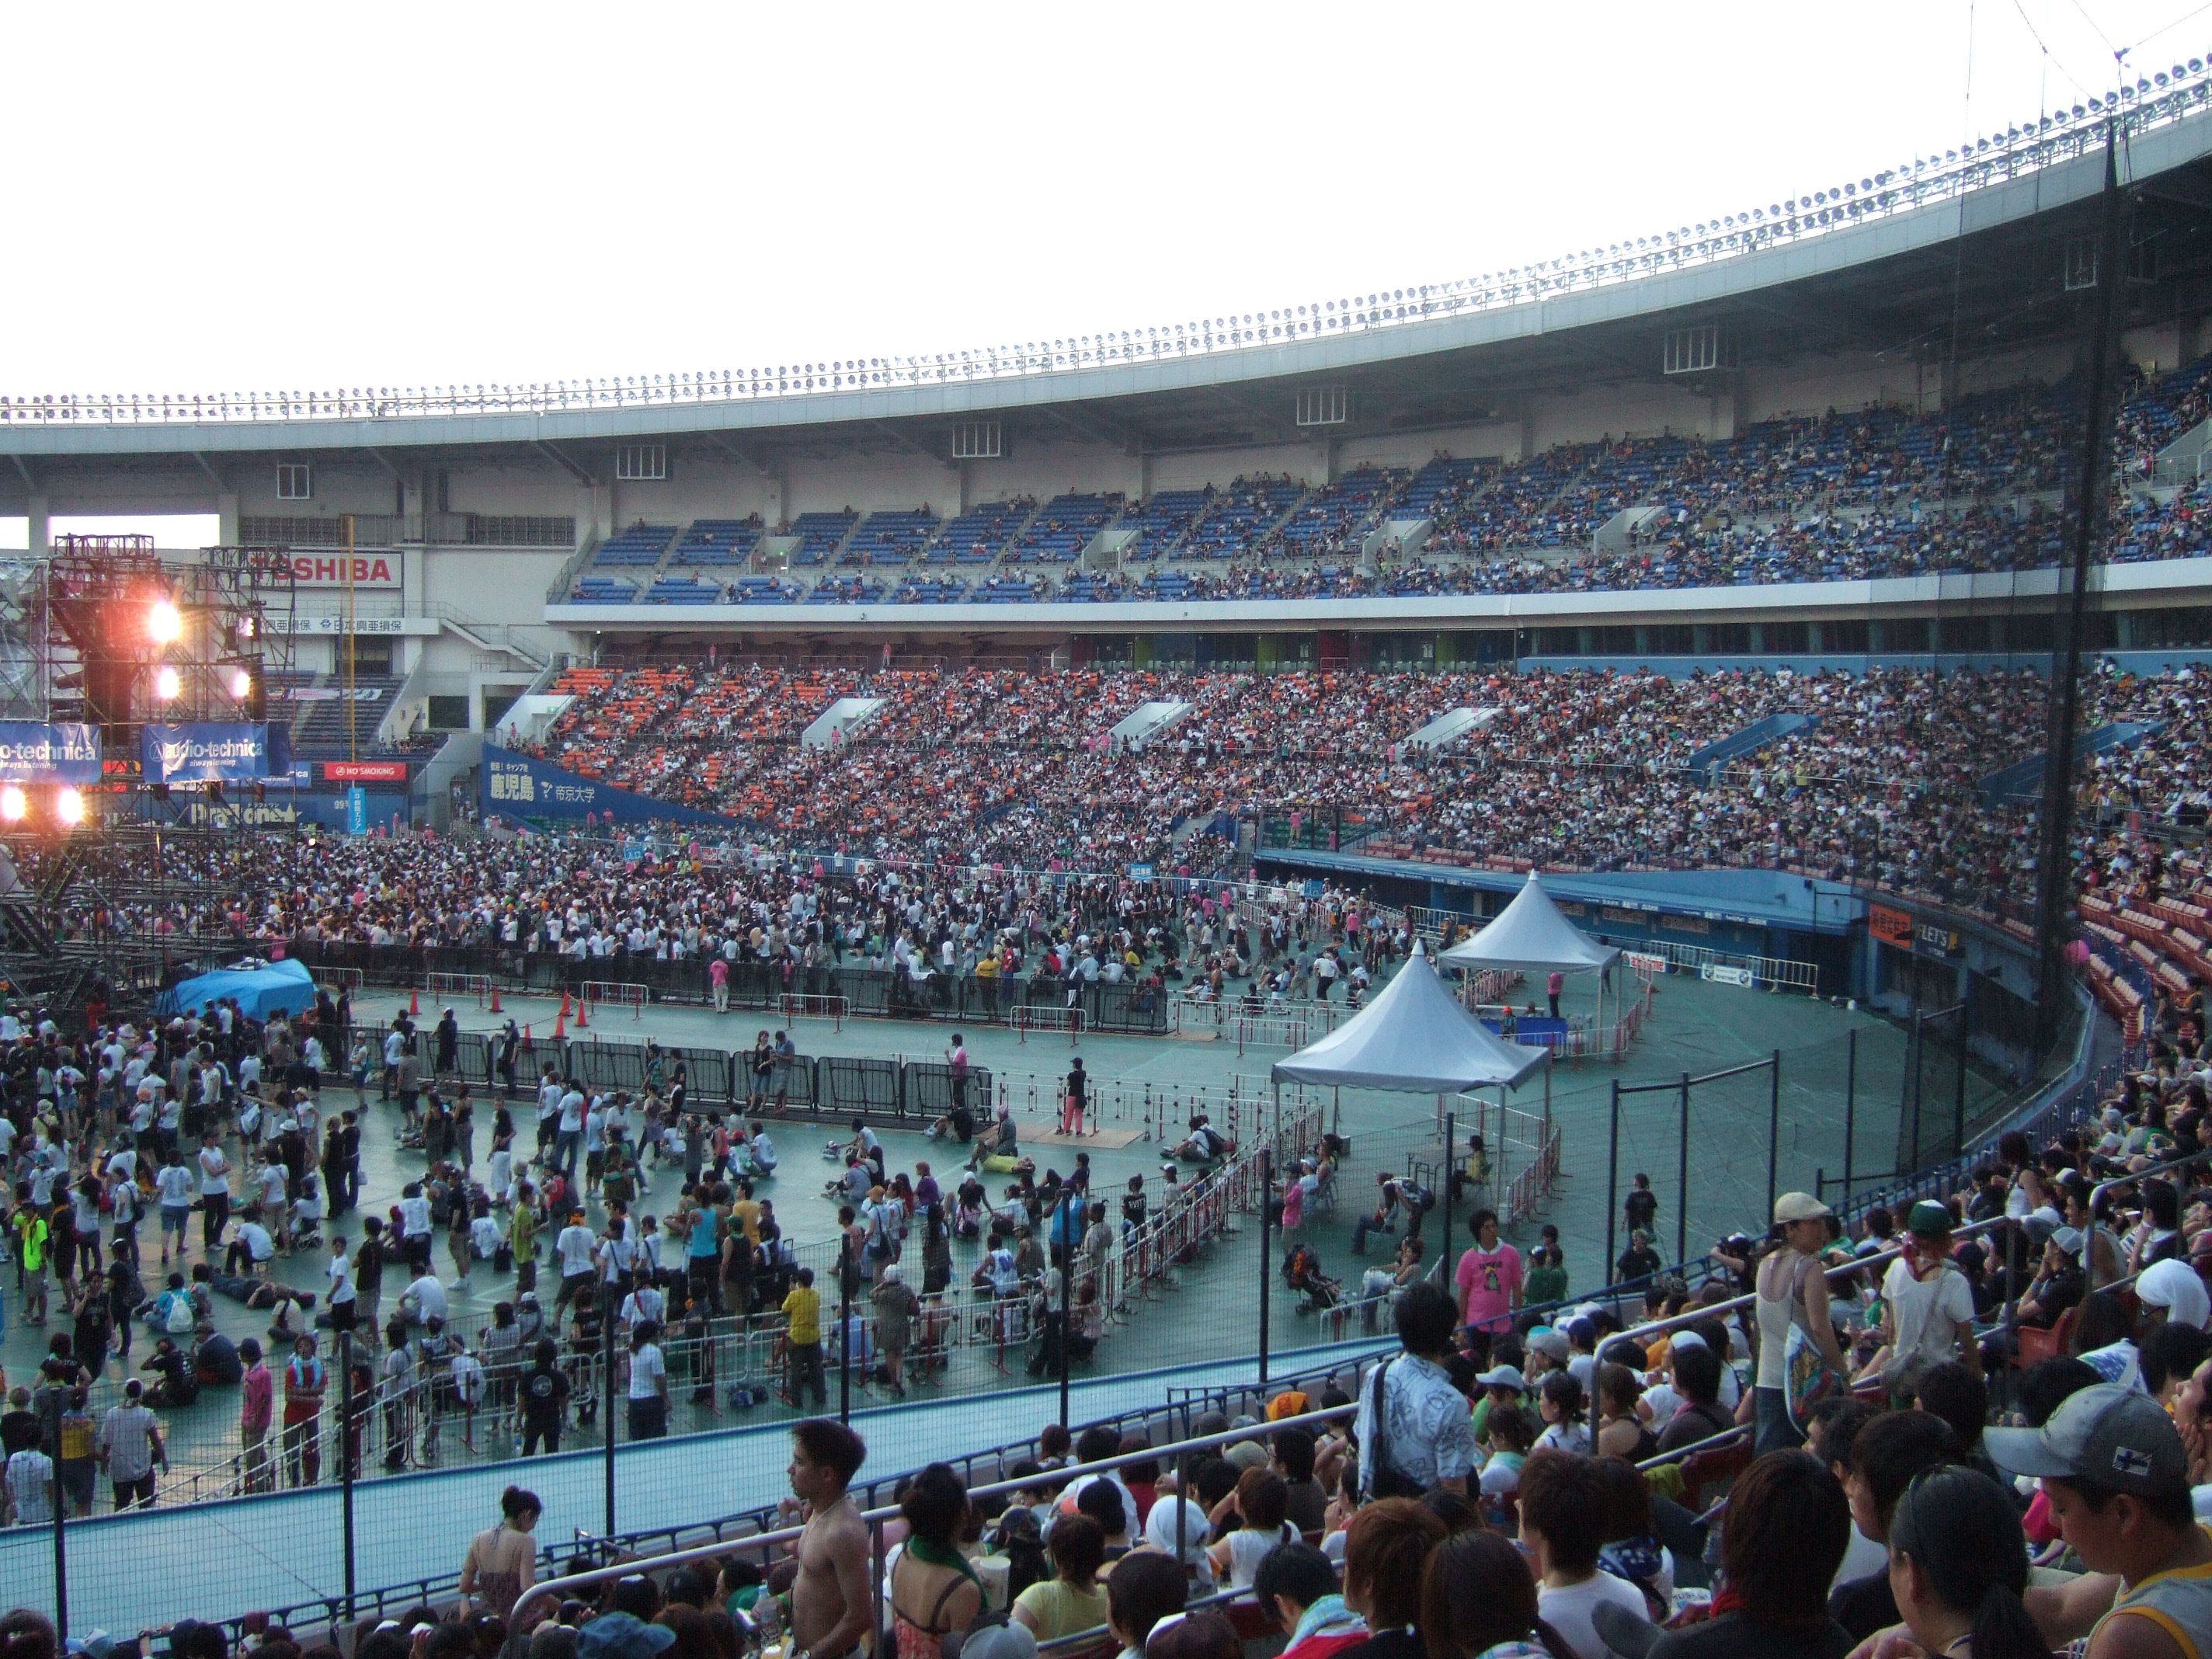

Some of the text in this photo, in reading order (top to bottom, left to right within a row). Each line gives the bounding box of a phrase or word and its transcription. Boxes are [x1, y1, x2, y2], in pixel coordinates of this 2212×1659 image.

[250, 557, 392, 582] TOSHIBA
[491, 774, 534, 802] 鹿児島
[555, 785, 595, 803] 帝京大学
